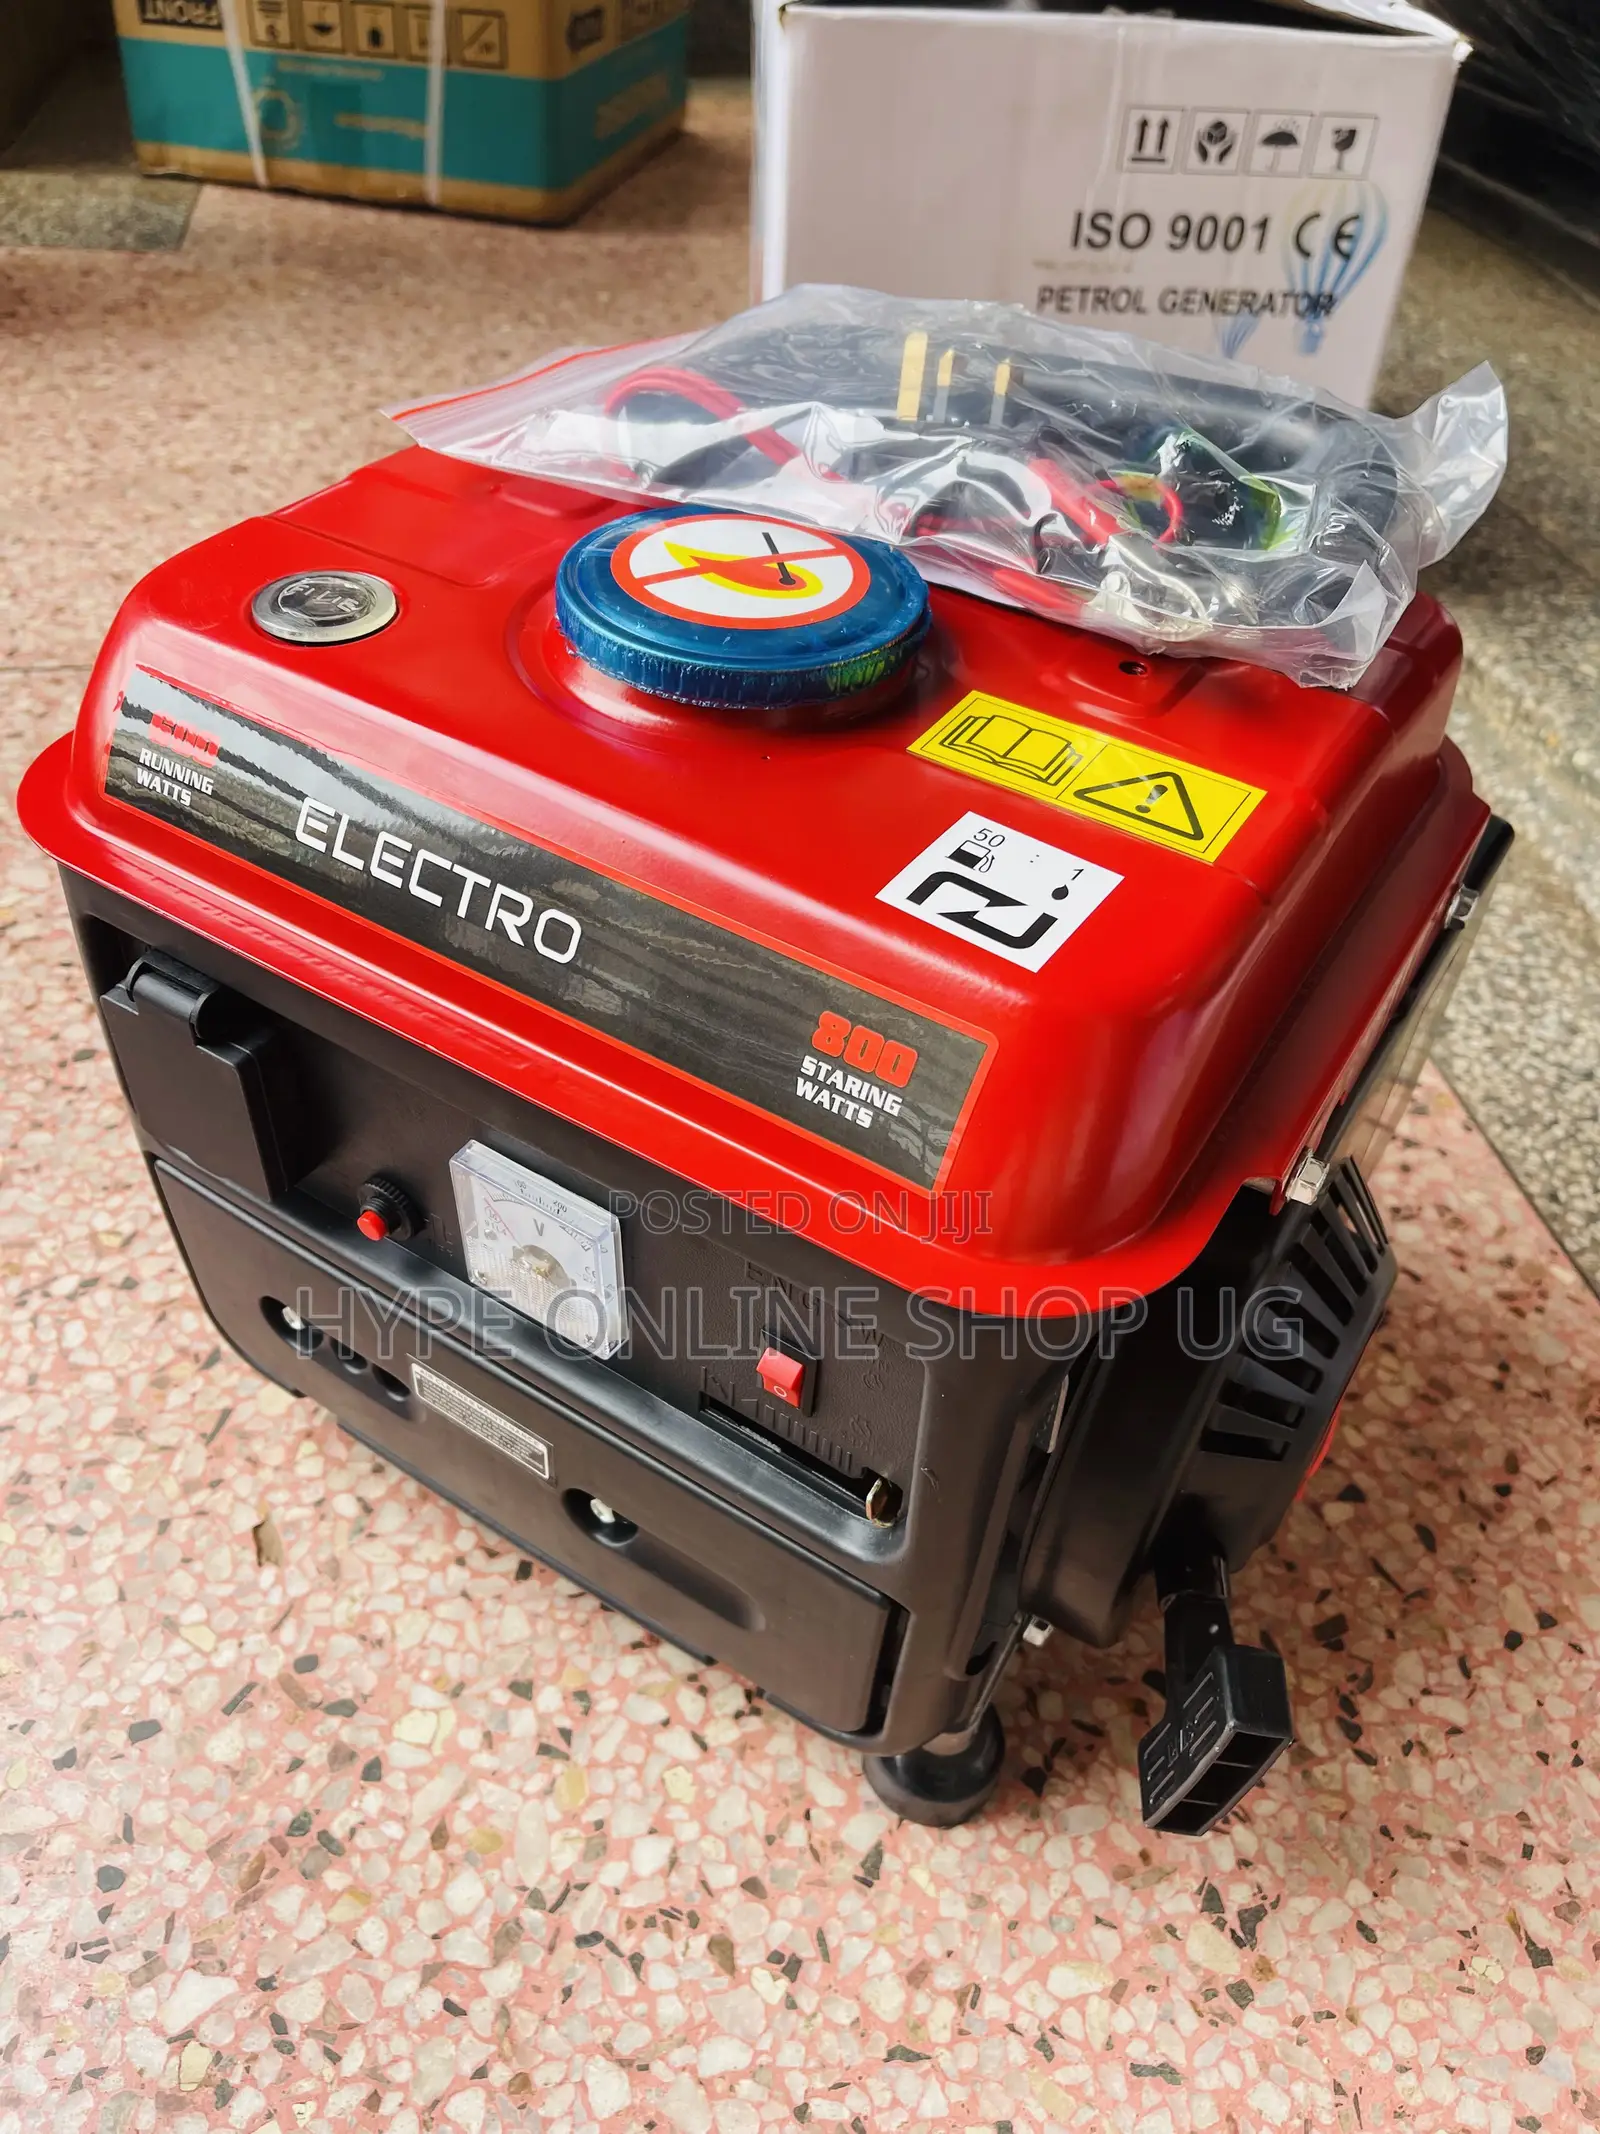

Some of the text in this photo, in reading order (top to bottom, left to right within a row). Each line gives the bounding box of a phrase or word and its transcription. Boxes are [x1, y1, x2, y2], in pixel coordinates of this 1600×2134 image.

[1070, 211, 1151, 252] ISO
[1167, 213, 1271, 255] 9001
[1036, 284, 1339, 319] PETROL GENERATOR
[136, 767, 192, 807] WATTS
[138, 747, 214, 796] RUNNING
[972, 827, 1007, 848] 50
[1071, 867, 1085, 881] 1
[295, 796, 583, 964] ELECTRO
[811, 1010, 918, 1088] 800
[795, 1076, 874, 1129] WATTS
[800, 1054, 903, 1117] STARING
[532, 1217, 545, 1237] V
